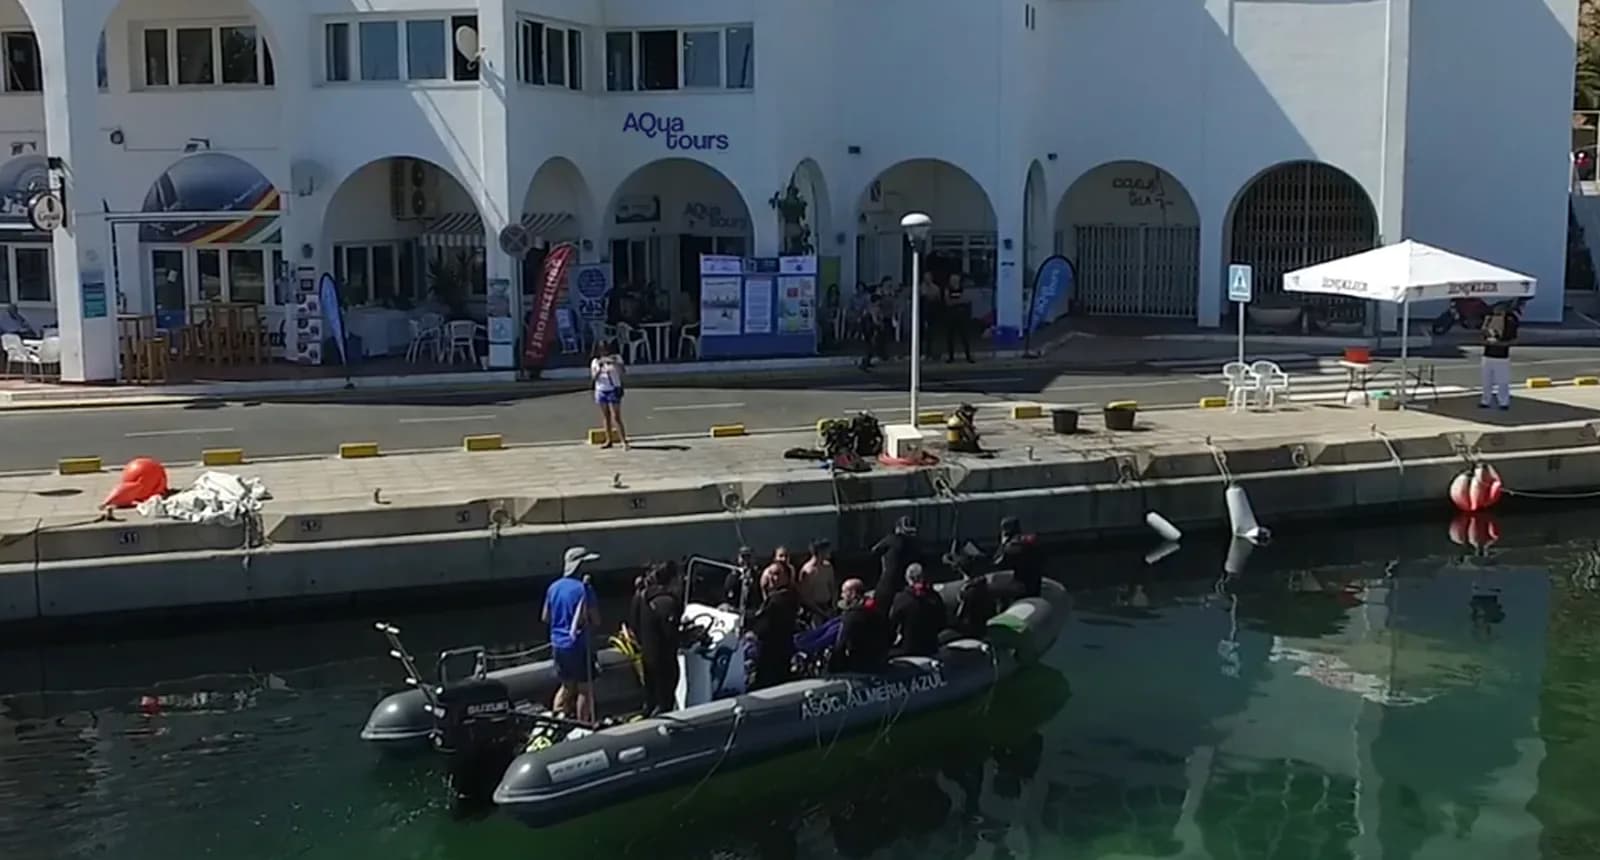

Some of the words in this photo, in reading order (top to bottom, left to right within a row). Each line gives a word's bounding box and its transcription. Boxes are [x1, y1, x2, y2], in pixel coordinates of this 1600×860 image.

[622, 111, 685, 139] AQua
[665, 131, 729, 150] tours
[911, 671, 948, 694] AZUL
